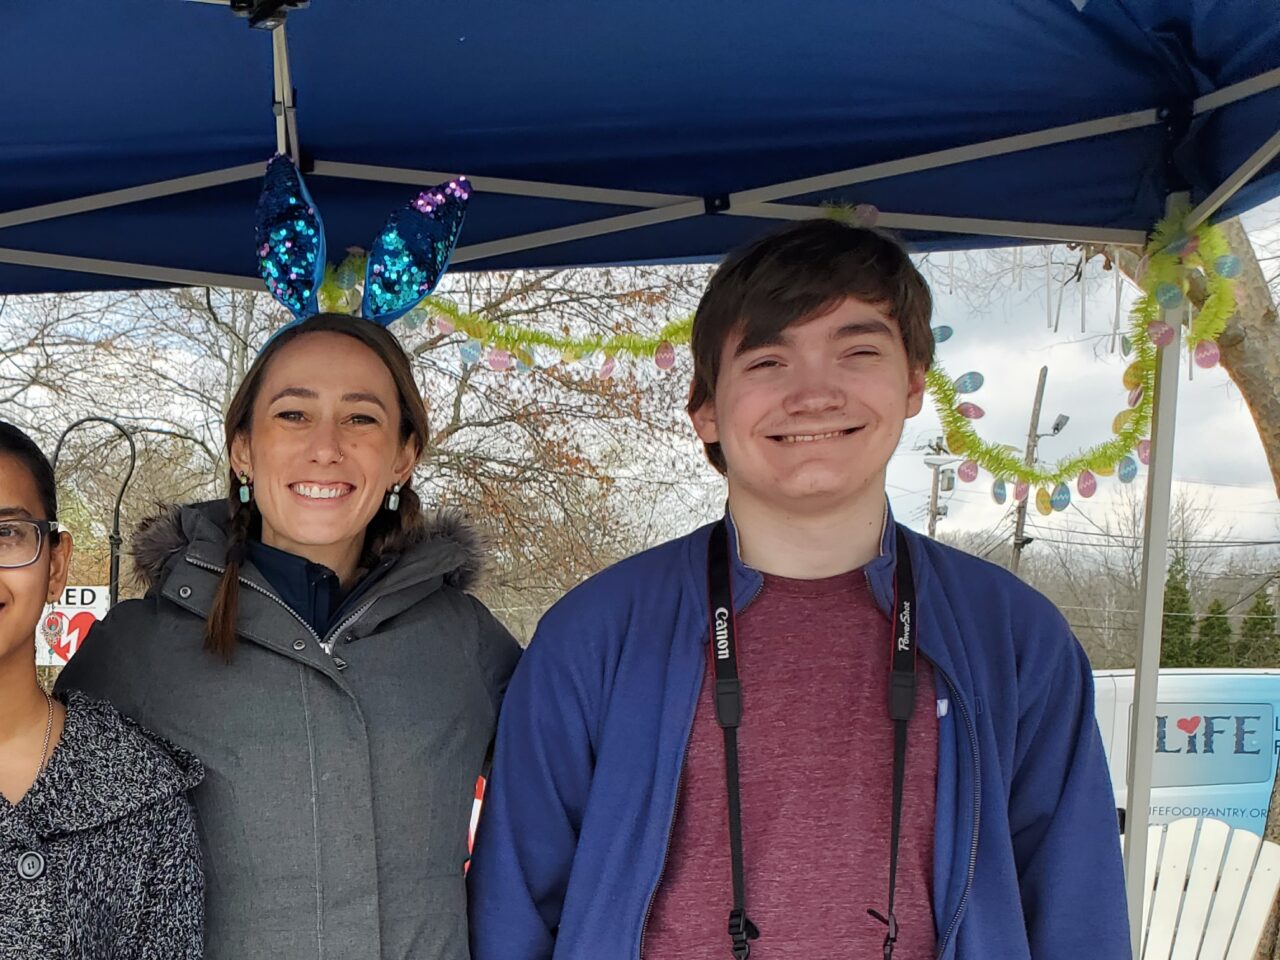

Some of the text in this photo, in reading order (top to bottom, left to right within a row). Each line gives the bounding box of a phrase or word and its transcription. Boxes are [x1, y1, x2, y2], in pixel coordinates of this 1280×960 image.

[61, 588, 96, 606] ED
[715, 606, 730, 659] Canon
[898, 601, 910, 651] PowerShot
[1155, 716, 1261, 754] LIFE
[1149, 807, 1267, 818] IFEFOODPANTRY.OR
